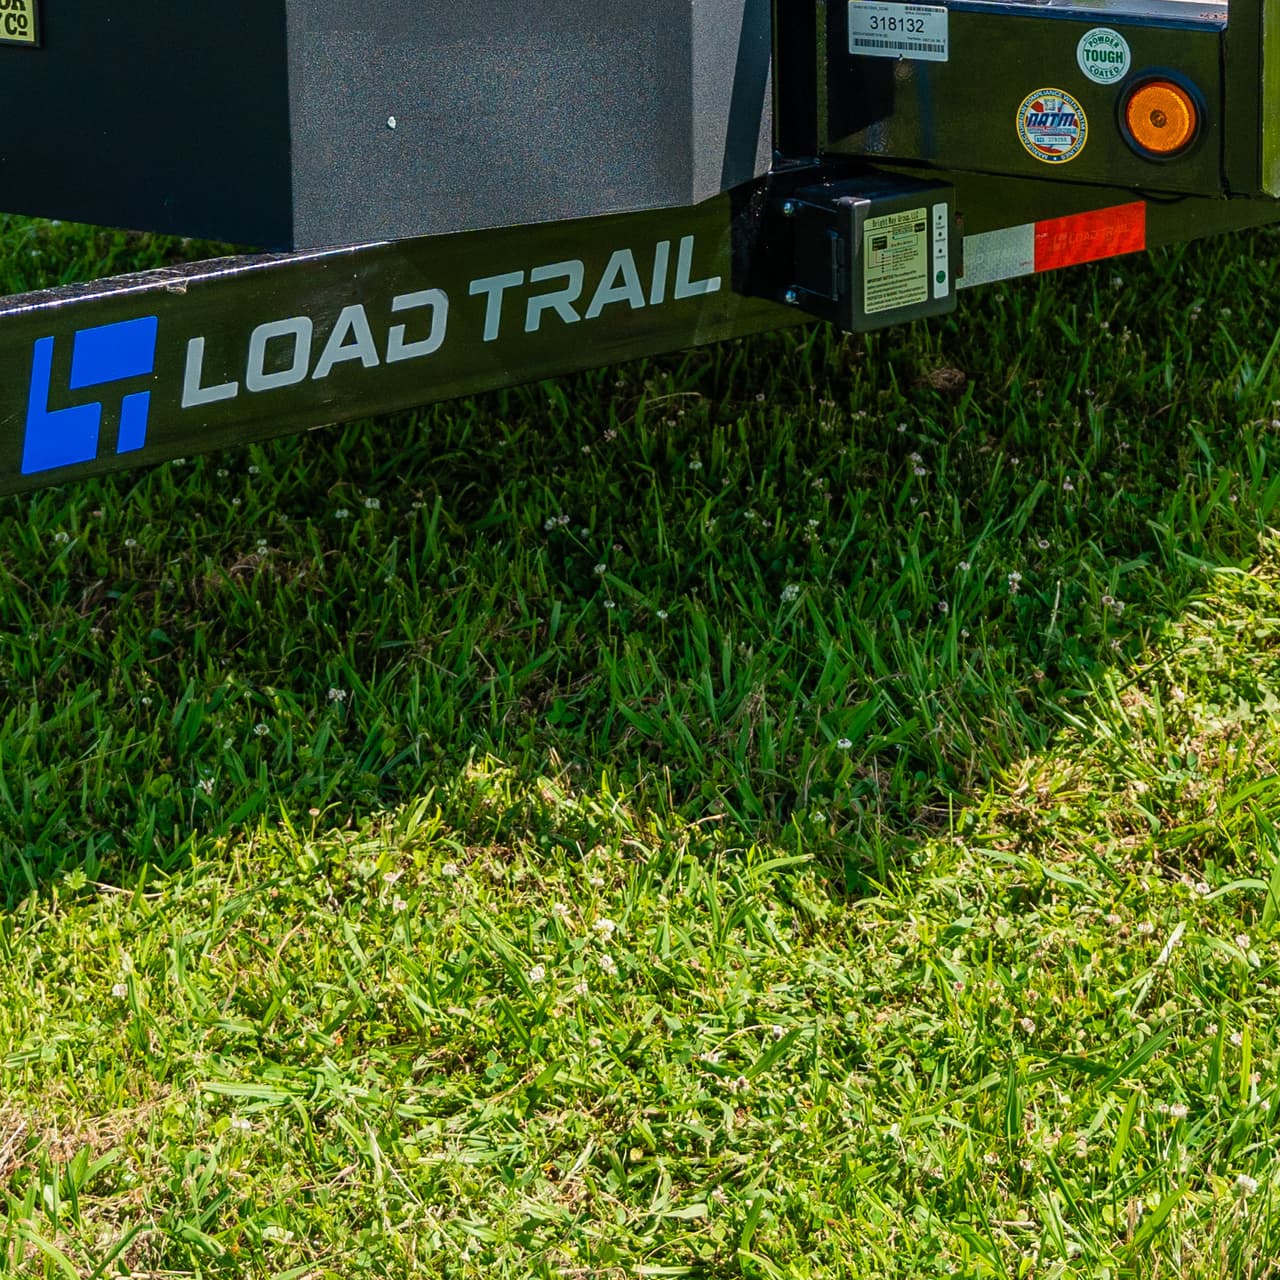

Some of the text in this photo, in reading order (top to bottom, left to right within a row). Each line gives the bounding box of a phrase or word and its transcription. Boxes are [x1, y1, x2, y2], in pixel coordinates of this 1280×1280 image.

[869, 15, 925, 34] 318132
[1083, 48, 1124, 64] TOUGH
[1089, 64, 1120, 78] COATED
[181, 287, 449, 409] LOAD
[468, 234, 722, 343] TRAIL
